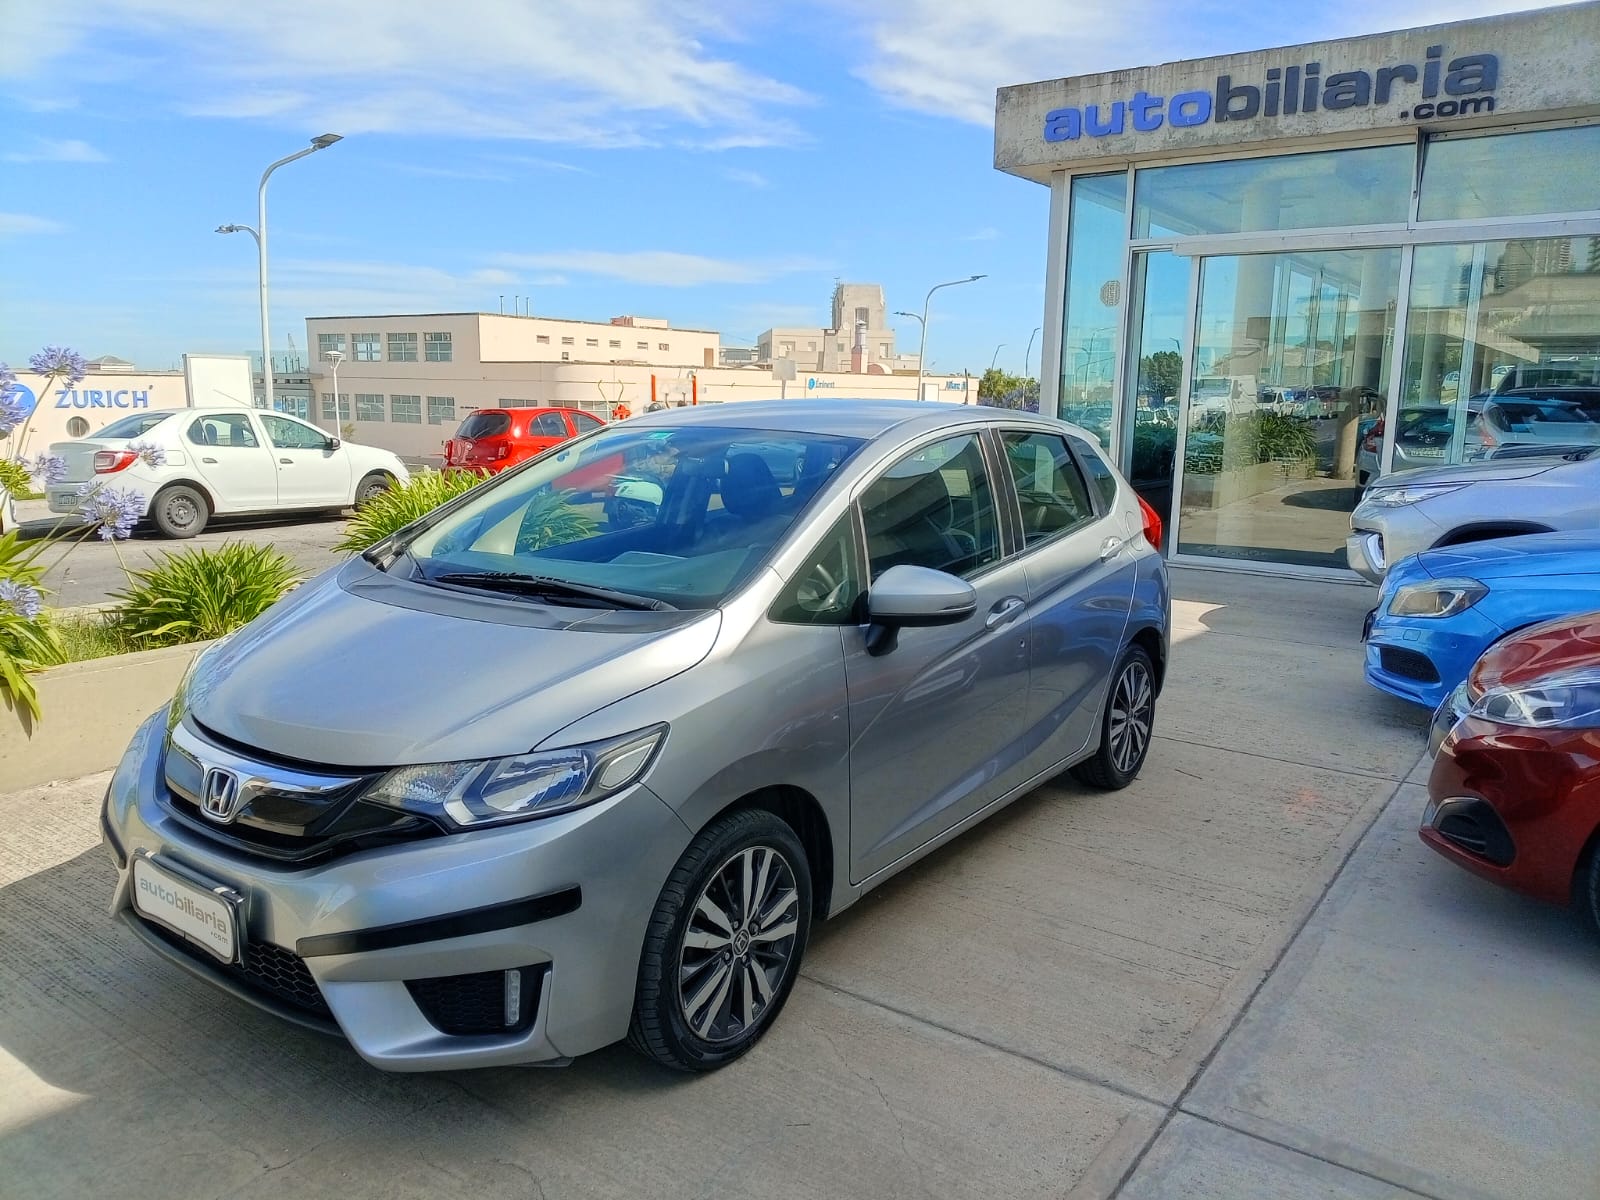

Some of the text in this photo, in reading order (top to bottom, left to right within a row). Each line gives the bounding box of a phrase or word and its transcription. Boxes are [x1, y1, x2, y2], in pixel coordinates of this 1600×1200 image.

[1043, 45, 1498, 143] autobiliaria
[1400, 96, 1495, 119] .com
[54, 389, 149, 409] ZURICH
[140, 878, 227, 934] autobiliaria
